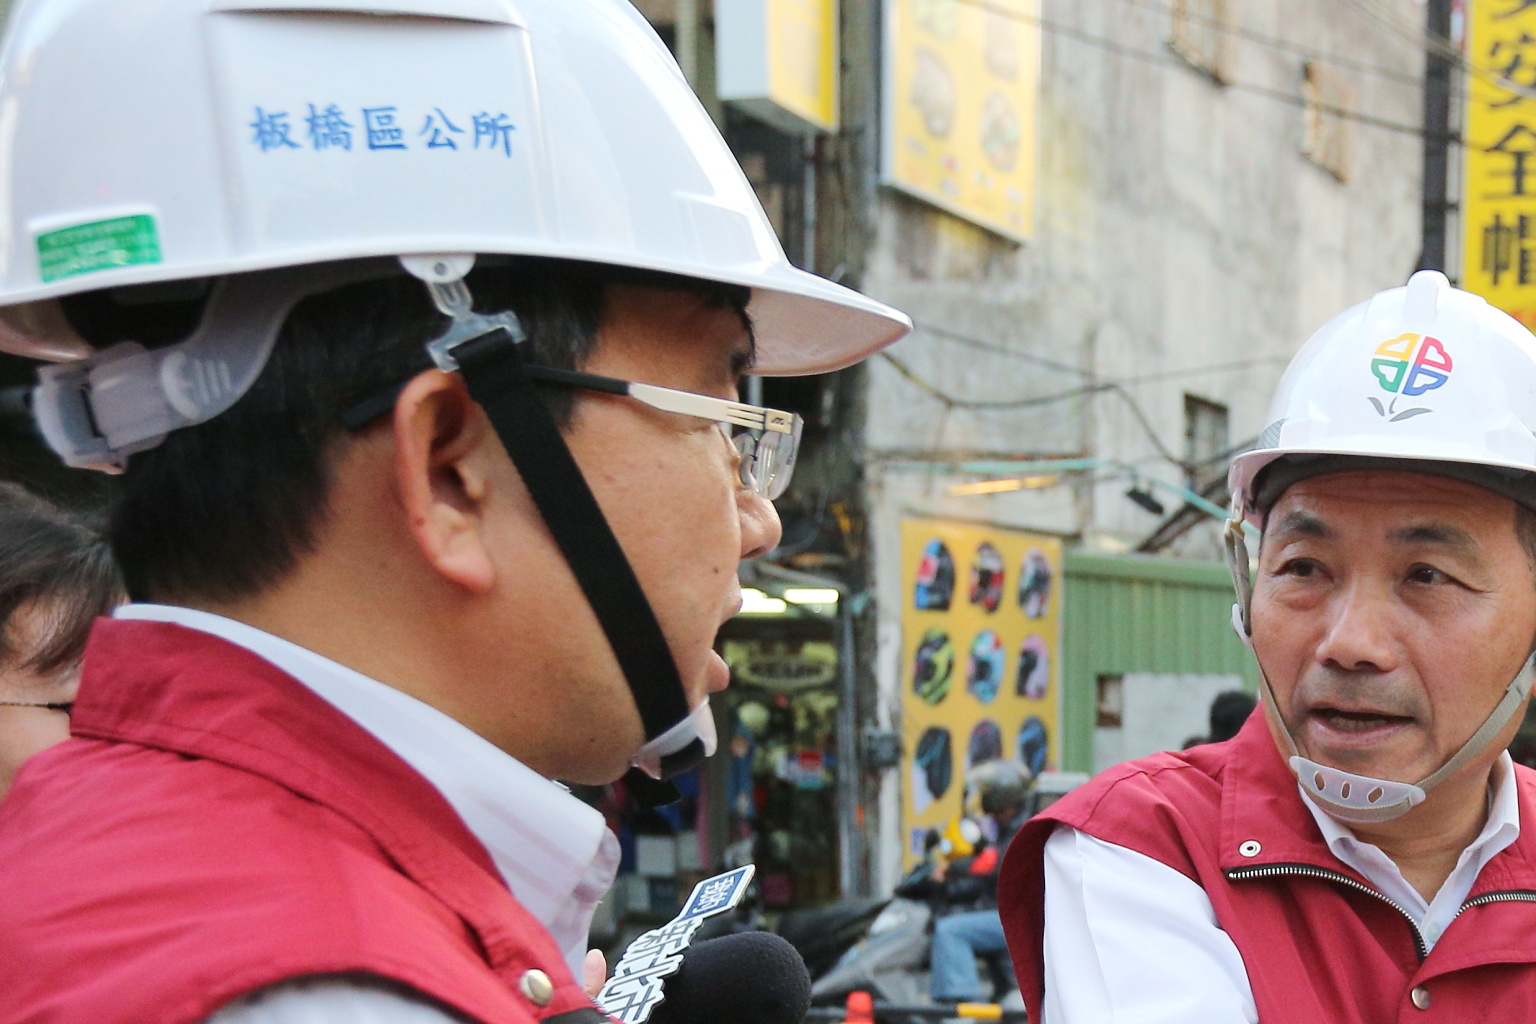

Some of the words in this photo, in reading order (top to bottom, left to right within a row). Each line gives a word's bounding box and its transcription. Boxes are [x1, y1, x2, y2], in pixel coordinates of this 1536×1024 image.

[250, 102, 518, 158] 板橋區公所
